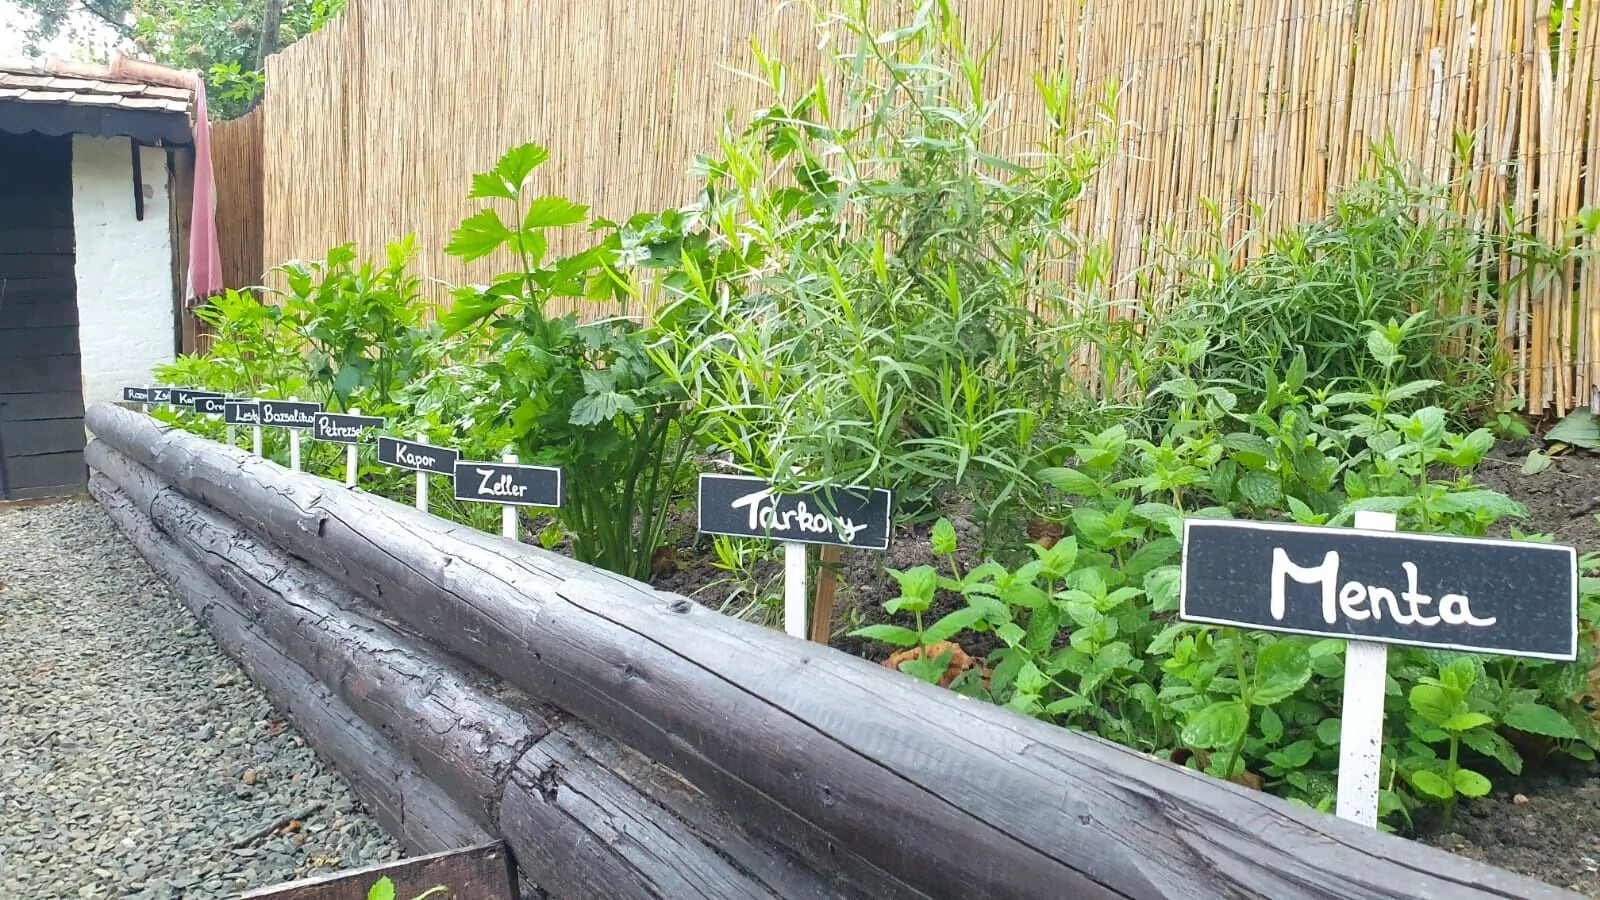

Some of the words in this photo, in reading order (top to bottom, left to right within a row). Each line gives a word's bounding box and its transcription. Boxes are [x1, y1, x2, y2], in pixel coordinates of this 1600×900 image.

[395, 442, 436, 471] Kapor
[475, 467, 529, 497] Zeller
[1270, 547, 1497, 628] Menta
